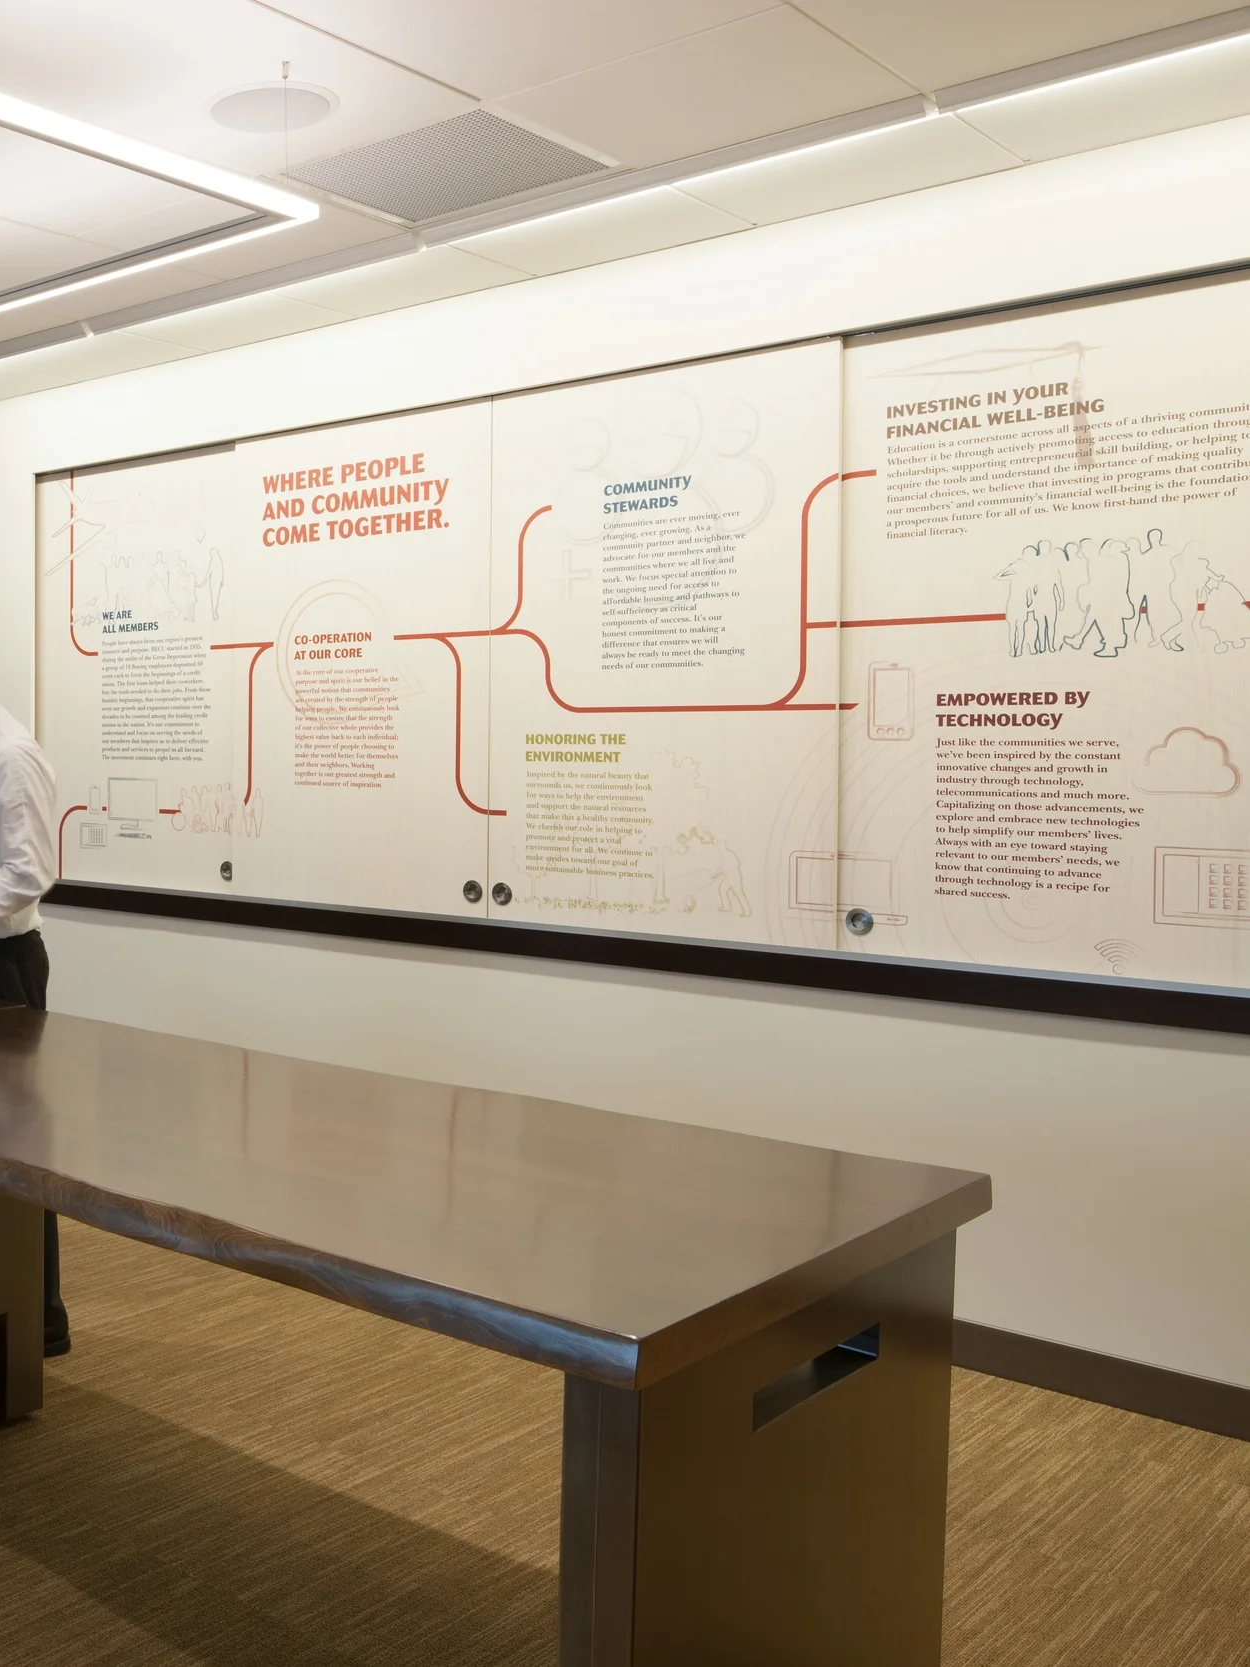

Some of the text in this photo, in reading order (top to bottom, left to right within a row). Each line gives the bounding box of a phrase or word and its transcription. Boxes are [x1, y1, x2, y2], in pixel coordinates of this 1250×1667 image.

[887, 382, 1068, 419] INVESTING IN YOUR
[887, 399, 1104, 439] FINANCIAL WELL-BEING
[263, 453, 425, 494] WHERE PEOPLE
[887, 481, 922, 492] acquire
[944, 475, 967, 484] tools
[970, 472, 988, 482] and
[992, 466, 1050, 480] understand
[1054, 464, 1070, 473] the
[1074, 459, 1137, 472] importance
[1141, 455, 1152, 464] of
[1157, 452, 1199, 462] making
[1203, 446, 1243, 460] quality
[604, 475, 691, 496] COMMUNITY
[263, 478, 448, 520] AND COMMUNITY
[604, 496, 678, 514] STEWARDS
[895, 516, 948, 529] prosperous
[952, 513, 982, 521] future
[986, 510, 1001, 518] for
[1004, 508, 1016, 516] all
[1020, 506, 1032, 515] of
[1104, 495, 1157, 507] first-hand
[1162, 494, 1179, 502] the
[1183, 492, 1220, 503] power
[1224, 488, 1235, 496] of
[263, 508, 449, 547] COME TOGETHER.
[887, 528, 926, 539] financial
[102, 610, 132, 620] WE ARE
[102, 622, 158, 634] ALL MEMBERS
[295, 632, 371, 645] CO-OPERATION
[294, 648, 362, 660] AT OUR CORE
[638, 650, 659, 659] ready
[708, 647, 745, 656] changing
[651, 660, 703, 668] communities.
[937, 691, 1090, 708] EMPOWERED BY
[936, 713, 1063, 730] TECHNOLOGY
[526, 734, 626, 745] HONORING THE
[936, 738, 955, 748] Just
[958, 738, 976, 746] like
[980, 738, 995, 746] the
[998, 738, 1066, 746] communities
[526, 751, 620, 763] ENVIRONMENT
[994, 751, 1036, 762] inspired
[1040, 751, 1052, 762] by
[1055, 751, 1071, 759] the
[527, 770, 556, 779] Inspired
[557, 771, 566, 780] by
[608, 772, 633, 781] beauty
[937, 763, 1107, 775] innovative changes and growth in
[587, 783, 634, 792] continuously
[937, 776, 1083, 788] industry through technology,
[937, 788, 1038, 798] telecommunications
[1064, 791, 1093, 799] much
[936, 800, 995, 812] Capitalizing
[1014, 802, 1042, 810] those
[1046, 803, 1125, 814] advancements,
[936, 813, 973, 823] explore
[977, 814, 995, 822] and
[998, 815, 1042, 824] embrace
[1071, 817, 1140, 829] technologies
[949, 825, 970, 836] help
[973, 827, 1014, 838] simplify
[1038, 830, 1091, 838] members’
[1095, 831, 1122, 839] lives.
[936, 838, 968, 848] Always
[971, 839, 992, 847] with
[1010, 843, 1027, 851] eye
[1070, 844, 1107, 855] staying
[936, 850, 974, 859] relevant
[1012, 854, 1063, 863] members’
[1067, 857, 1102, 867] needs,
[936, 862, 961, 870] know
[964, 864, 983, 872] that
[986, 866, 1041, 878] continuing
[1058, 869, 1101, 878] advance
[936, 874, 973, 886] through
[977, 878, 1032, 890] technology
[1056, 882, 1089, 893] recipe
[1094, 883, 1110, 892] for
[935, 887, 967, 896] shared
